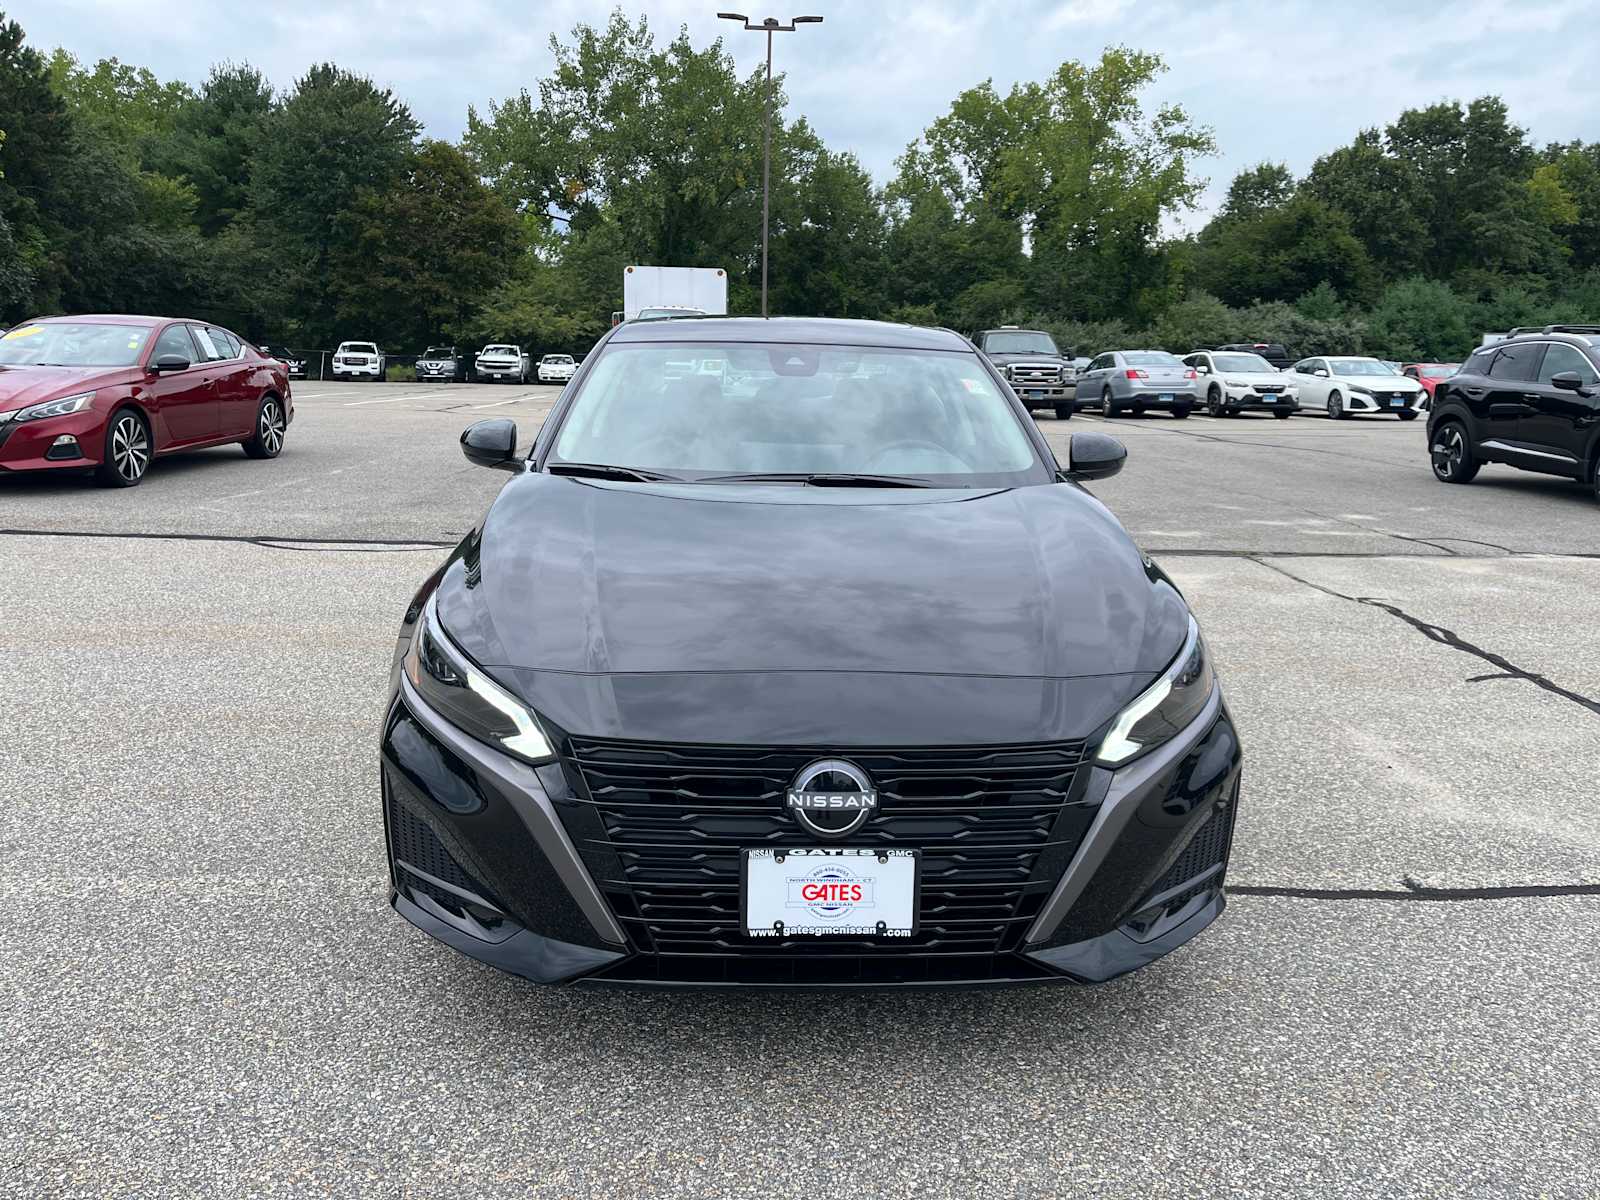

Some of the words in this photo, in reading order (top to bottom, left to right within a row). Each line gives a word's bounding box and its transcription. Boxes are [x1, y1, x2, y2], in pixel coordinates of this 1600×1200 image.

[789, 793, 875, 808] NISSAN
[749, 849, 775, 858] NISSAN
[788, 848, 876, 856] GATES
[886, 849, 913, 857] GMC
[802, 884, 862, 901] GATES
[782, 926, 877, 937] gatesgmcnissan
